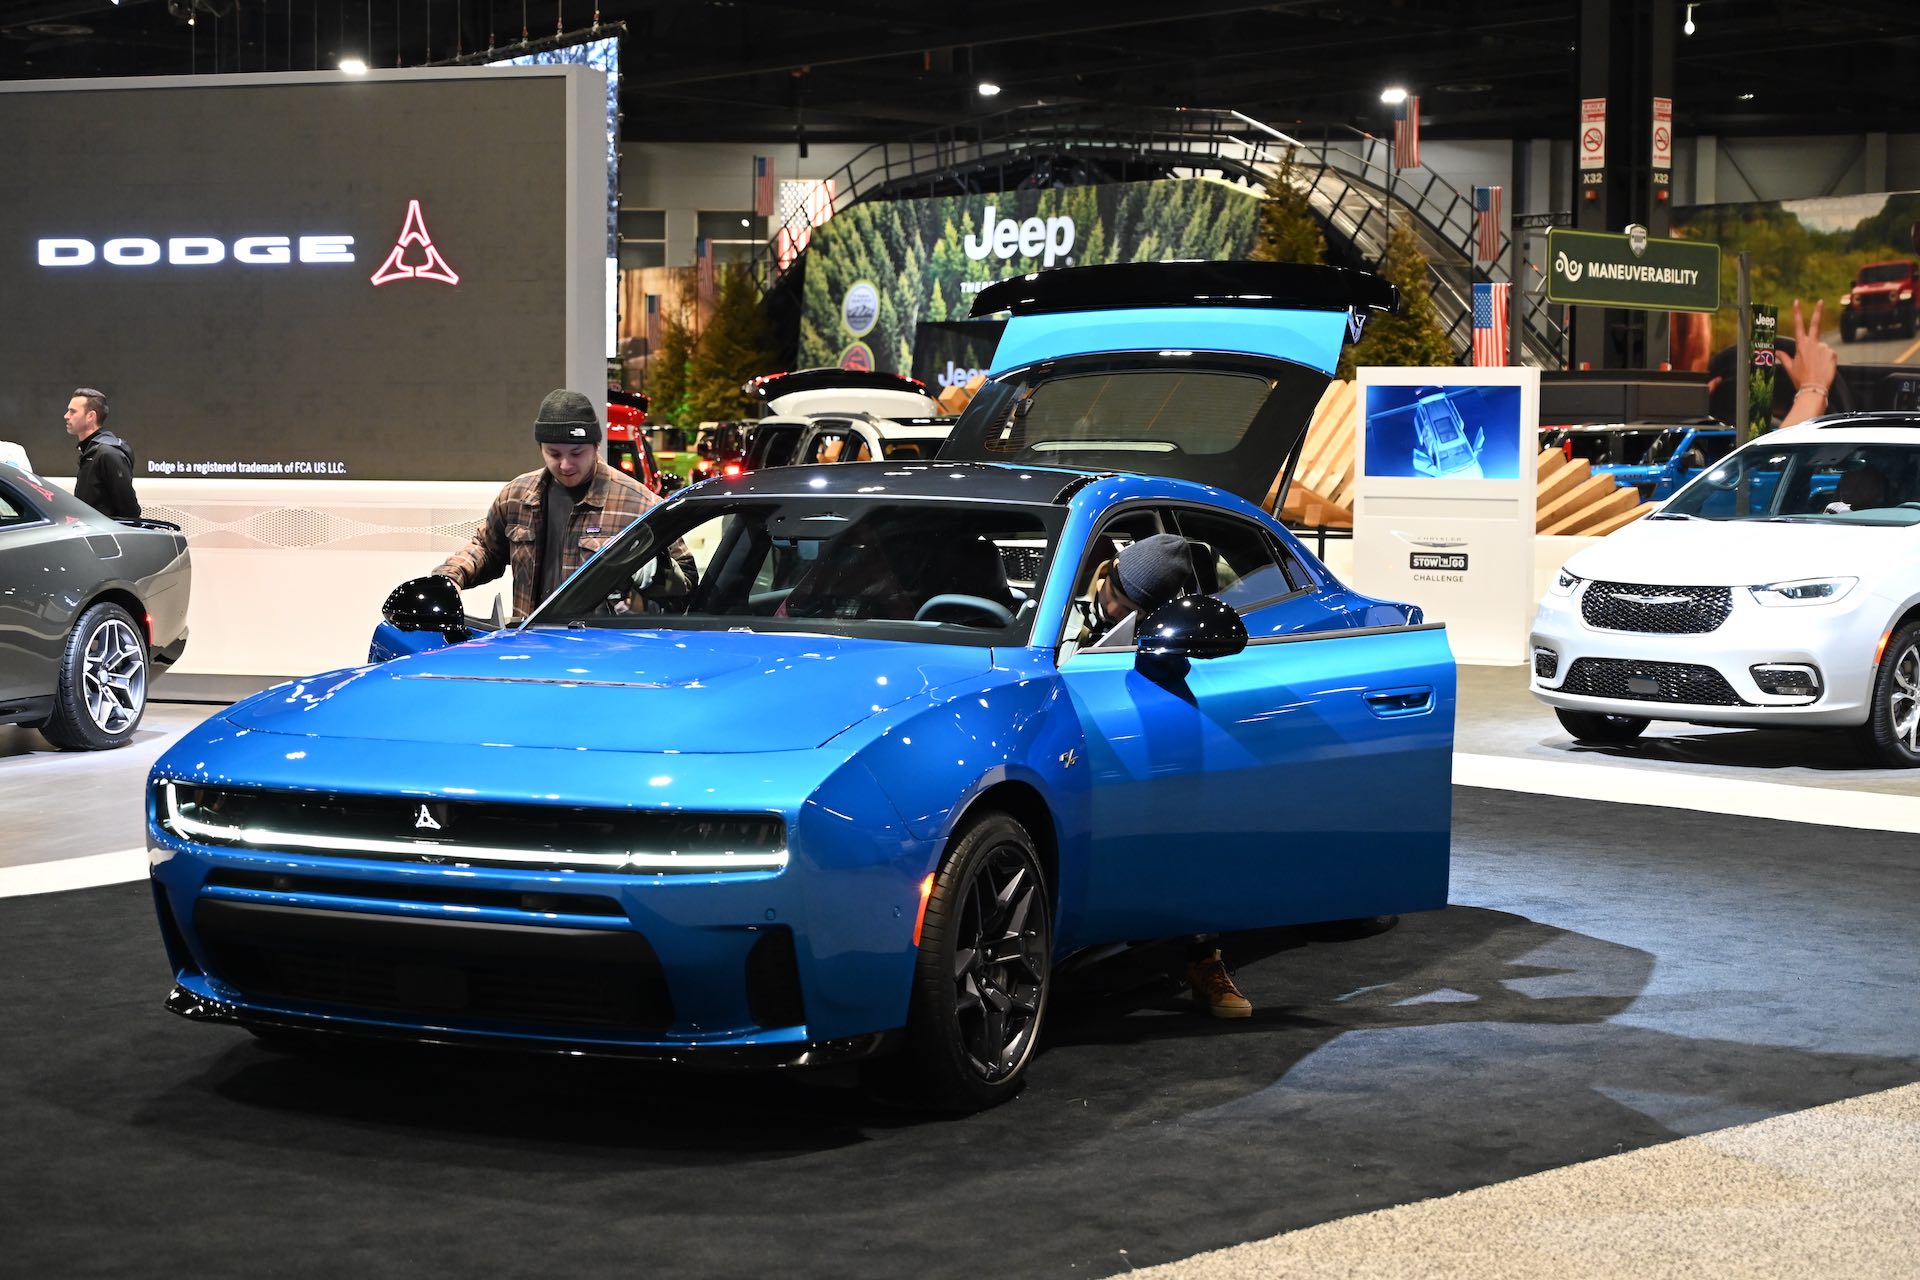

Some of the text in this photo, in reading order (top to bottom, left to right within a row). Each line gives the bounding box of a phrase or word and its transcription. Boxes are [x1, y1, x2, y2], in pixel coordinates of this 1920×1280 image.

[1583, 173, 1603, 184] X32
[1653, 173, 1669, 184] X32
[964, 205, 1076, 267] Jeep
[38, 235, 355, 266] DODGE
[1588, 261, 1698, 285] MANEUVERABILITY
[1755, 312, 1776, 328] Jeep
[937, 360, 991, 388] Jee
[148, 461, 347, 475] Dodge is a registered trademark of FCA US LLC.
[1413, 558, 1438, 567] STOW
[1452, 559, 1465, 567] GO
[1413, 574, 1464, 583] CHALLENGE
